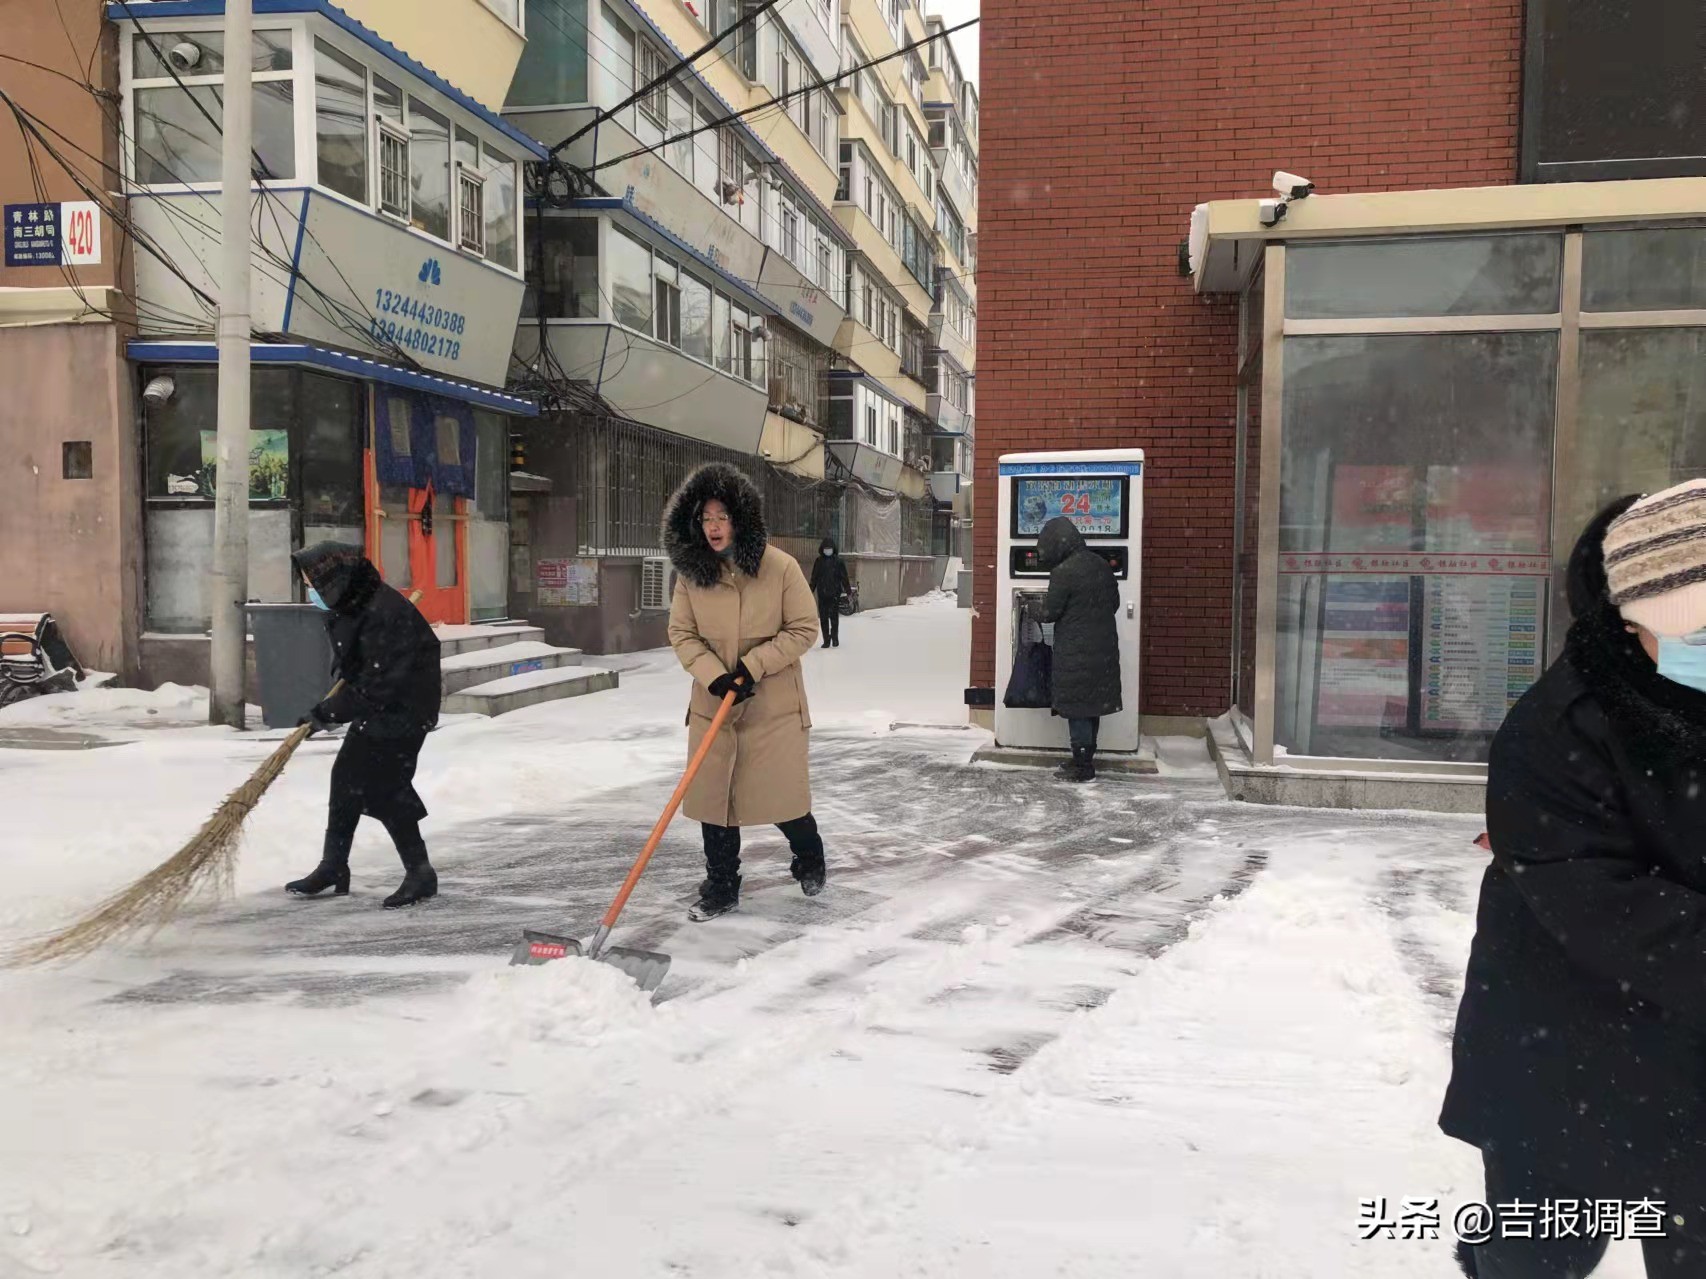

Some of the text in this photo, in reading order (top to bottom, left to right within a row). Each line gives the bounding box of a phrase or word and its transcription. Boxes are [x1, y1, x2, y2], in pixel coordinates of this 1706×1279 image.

[12, 209, 54, 223] 青林路
[13, 224, 55, 238] 南三胡同
[69, 210, 93, 256] 420
[375, 288, 466, 335] 13244430388
[1060, 493, 1090, 514] 24
